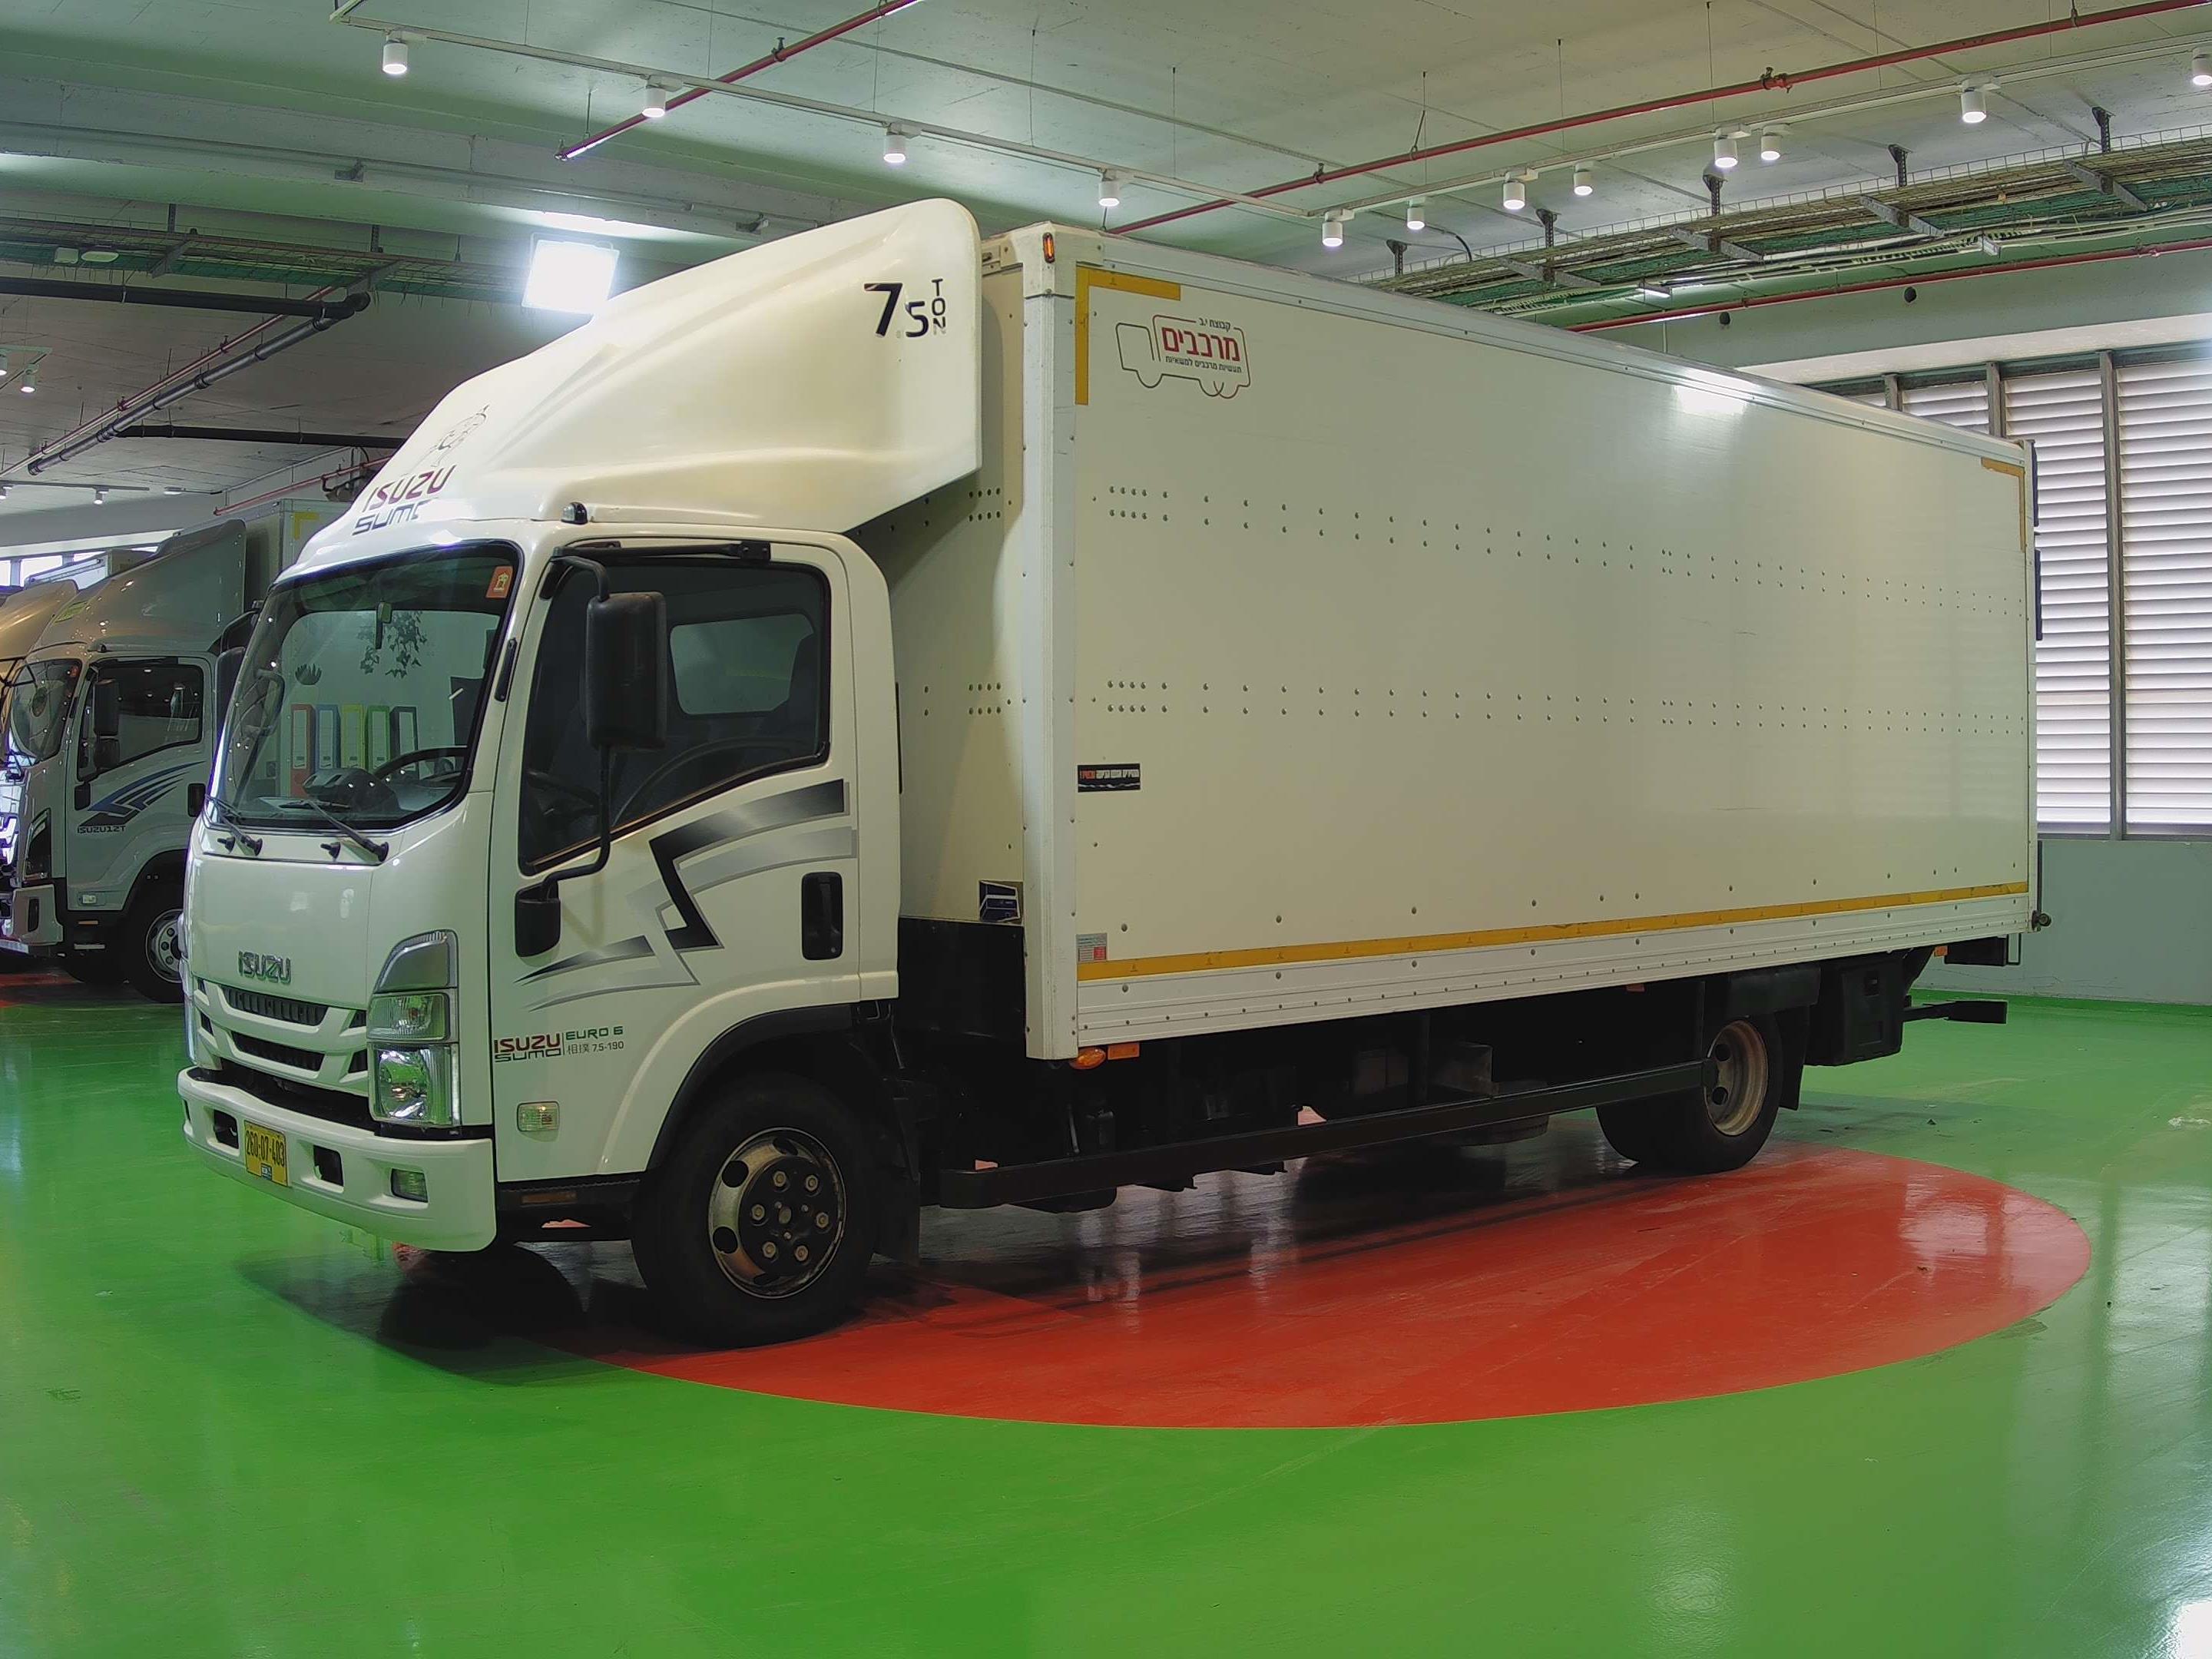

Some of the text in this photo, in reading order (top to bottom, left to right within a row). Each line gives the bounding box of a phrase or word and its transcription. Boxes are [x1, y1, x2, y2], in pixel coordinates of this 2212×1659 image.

[1161, 326, 1240, 362] מרכבים
[362, 464, 457, 513] ISUZU
[238, 950, 292, 985] ISUZU
[494, 1032, 561, 1054] ISUZU
[565, 1025, 624, 1041] EURO 6
[494, 1048, 561, 1063] SUMO
